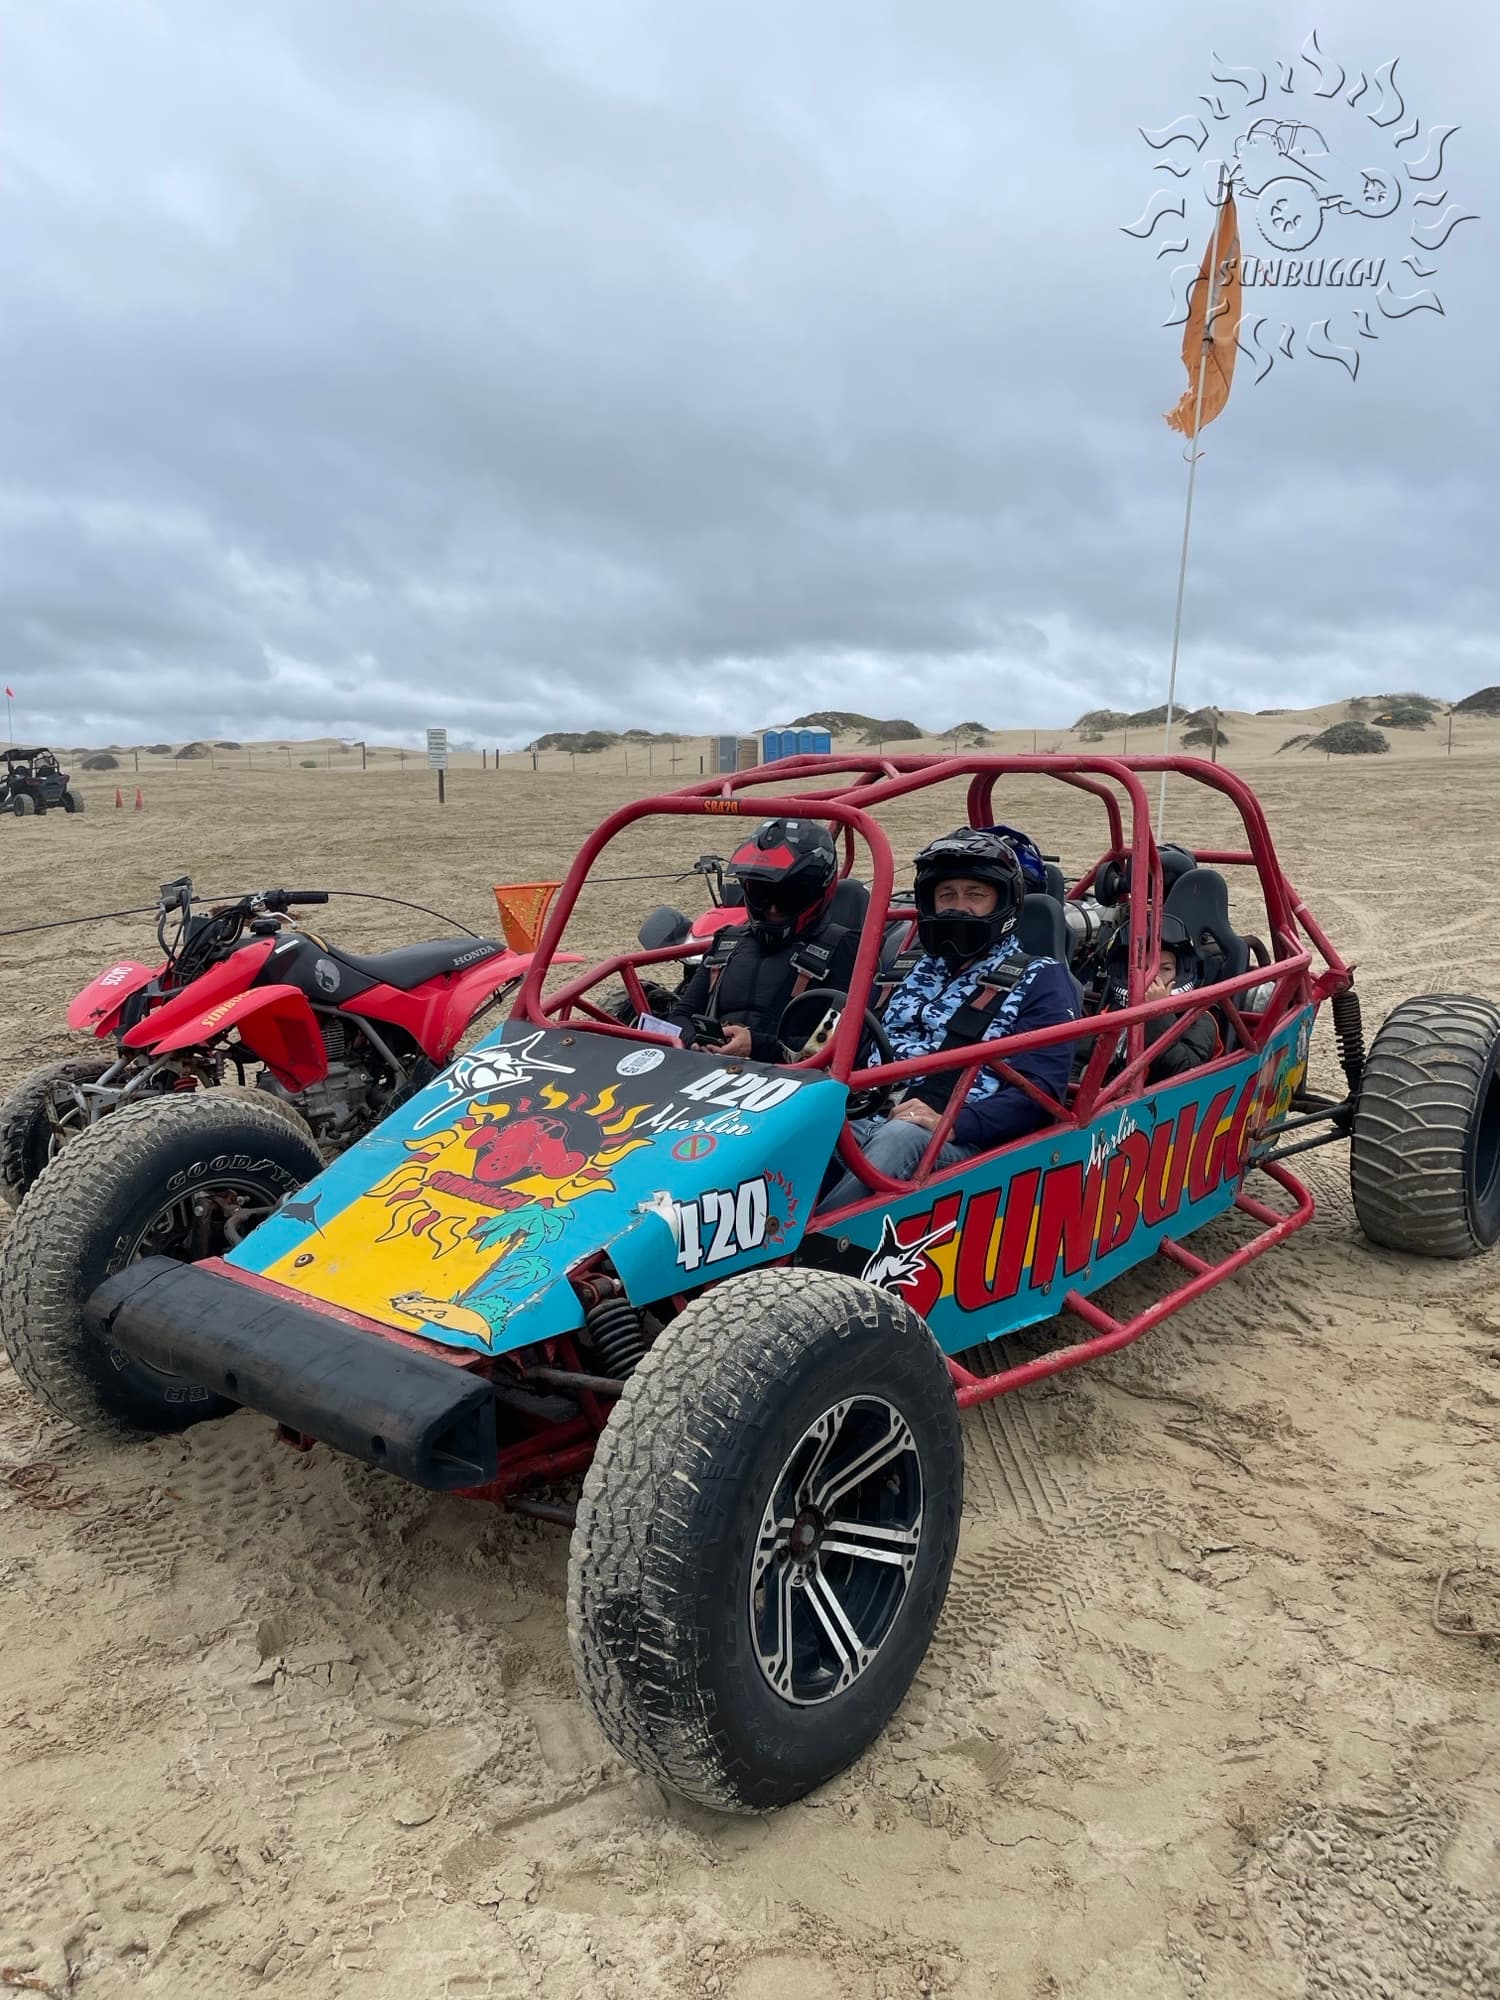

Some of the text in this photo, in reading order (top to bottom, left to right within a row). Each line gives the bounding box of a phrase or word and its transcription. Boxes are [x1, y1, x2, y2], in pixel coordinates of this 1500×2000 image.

[704, 799, 738, 813] SB420
[453, 945, 496, 966] HONDA
[679, 1068, 802, 1112] 420
[634, 1102, 752, 1136] Marlin
[1085, 1108, 1137, 1176] Marlin
[672, 1175, 768, 1271] 420
